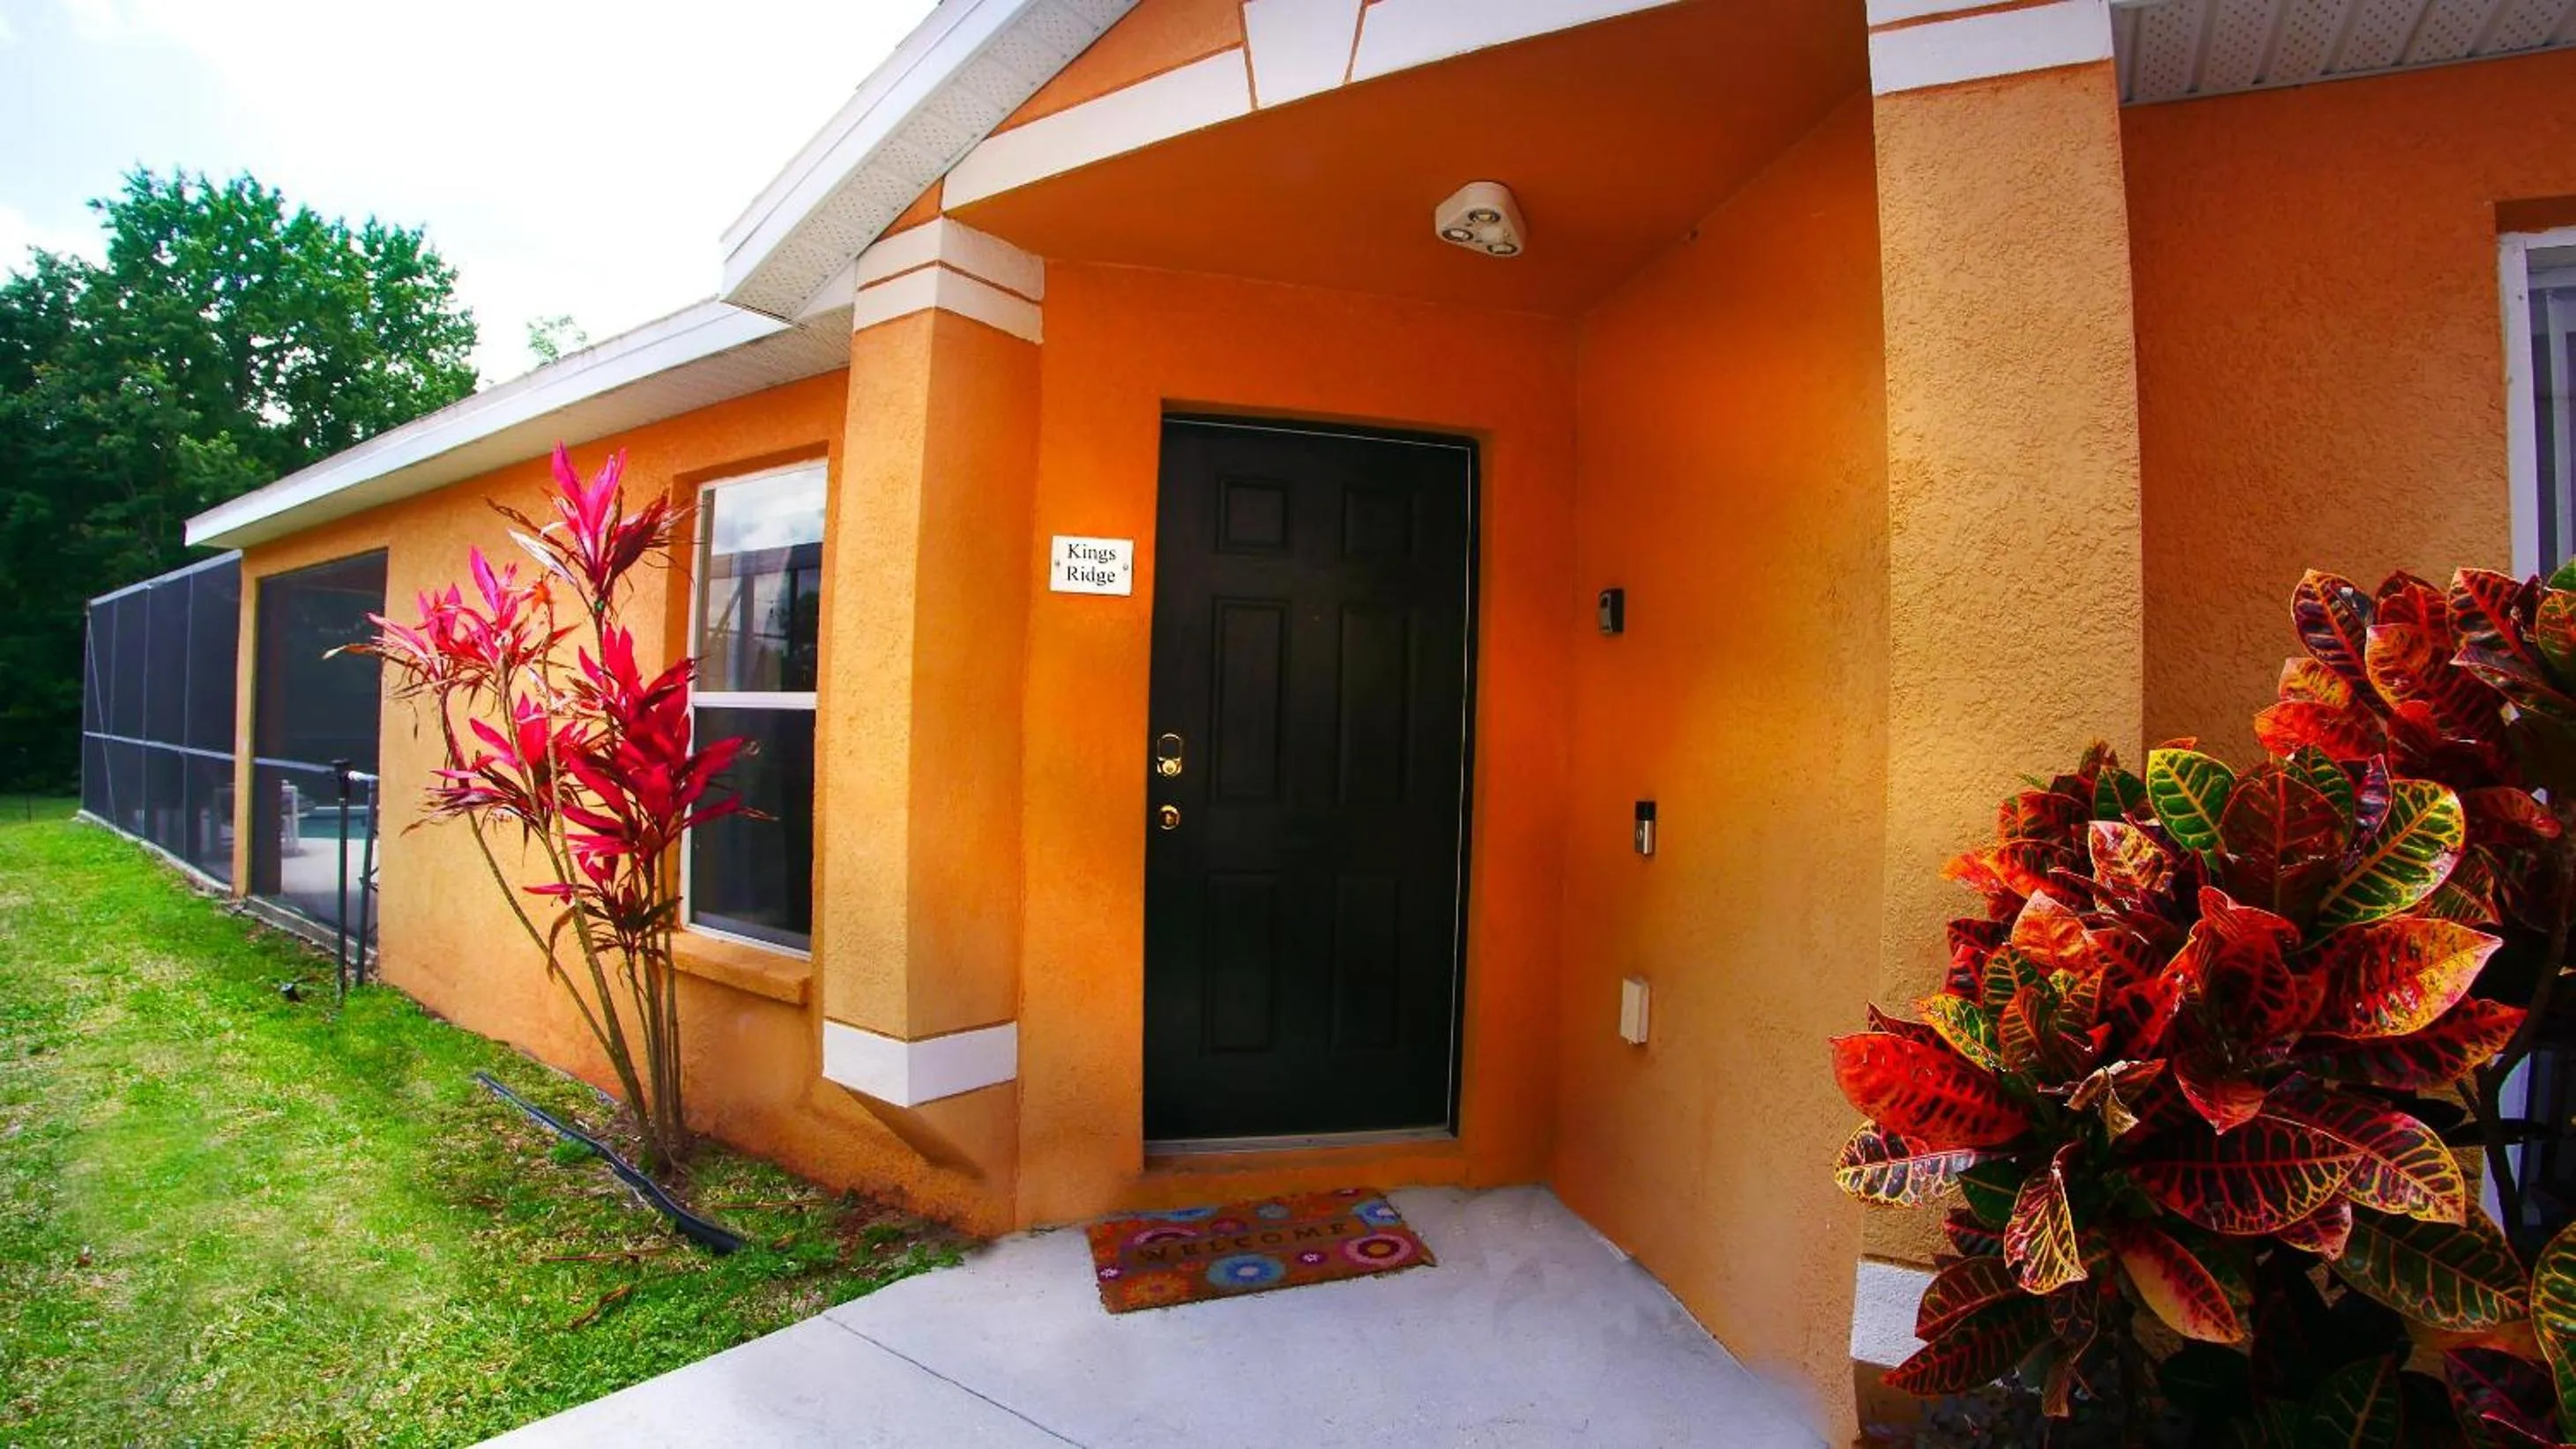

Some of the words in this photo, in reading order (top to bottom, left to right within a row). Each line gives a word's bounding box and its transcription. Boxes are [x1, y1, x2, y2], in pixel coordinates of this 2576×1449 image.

[1068, 543, 1117, 564] Kings
[1067, 566, 1115, 586] Ridge
[1138, 1222, 1346, 1262] WELCOME
